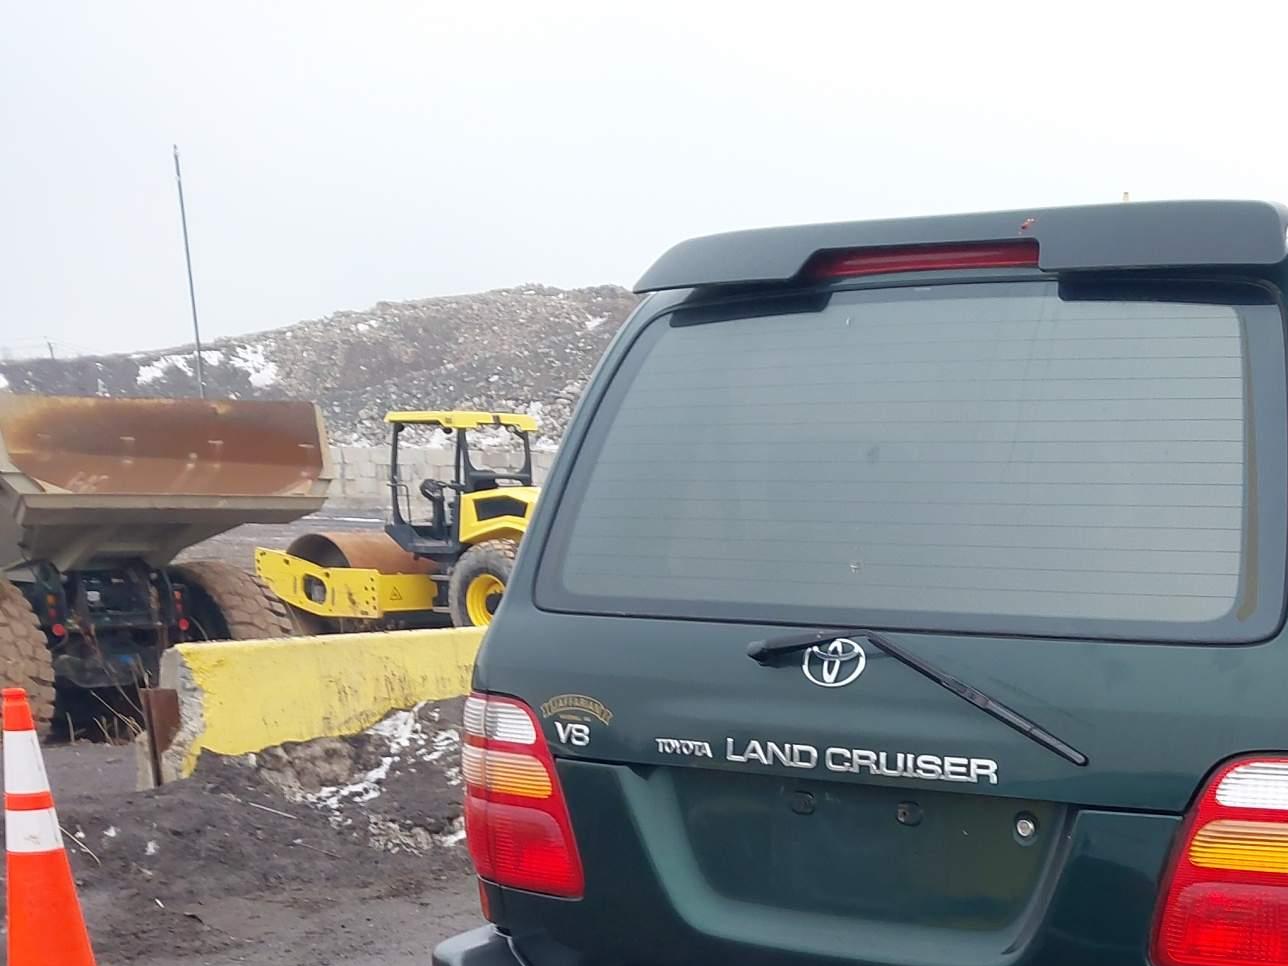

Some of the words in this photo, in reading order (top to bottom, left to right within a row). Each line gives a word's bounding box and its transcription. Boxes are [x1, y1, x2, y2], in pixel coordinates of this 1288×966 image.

[553, 721, 590, 746] V8
[655, 738, 713, 758] TOYOTA
[726, 737, 818, 768] LAND
[825, 746, 998, 785] CRUISER
